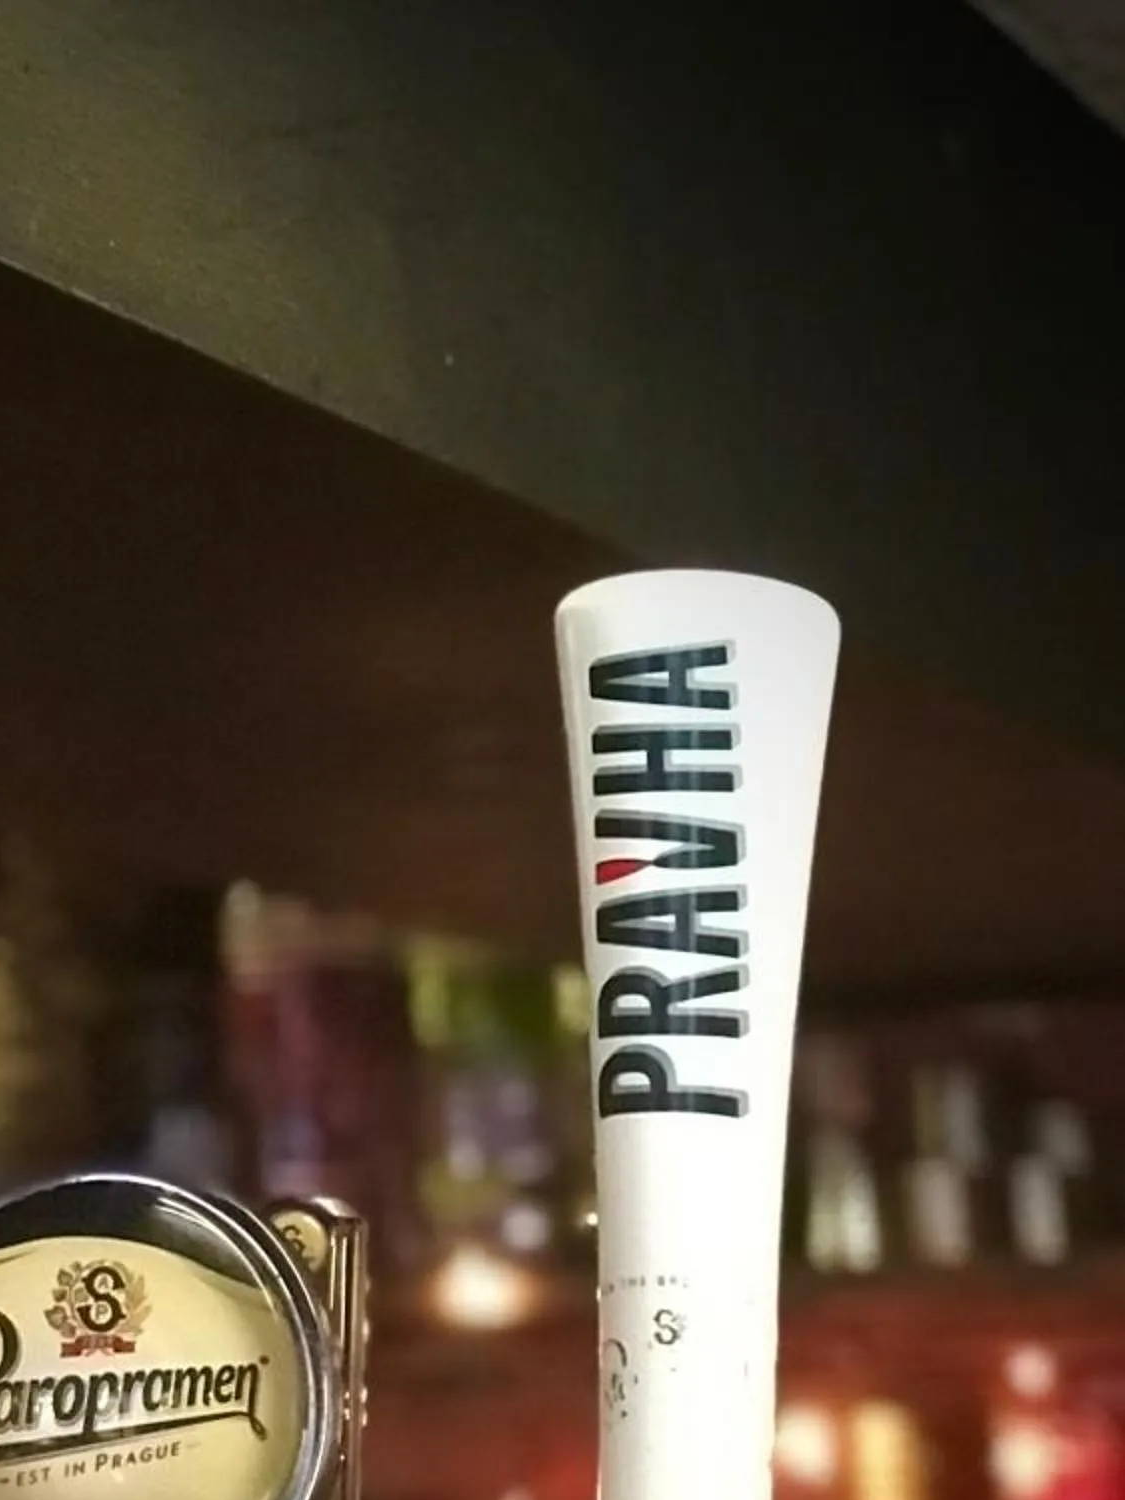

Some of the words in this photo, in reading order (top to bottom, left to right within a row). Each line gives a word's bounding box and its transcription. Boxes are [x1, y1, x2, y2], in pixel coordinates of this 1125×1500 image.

[589, 639, 749, 1119] PRAVHA
[16, 1467, 51, 1487] EST
[64, 1460, 86, 1478] IN
